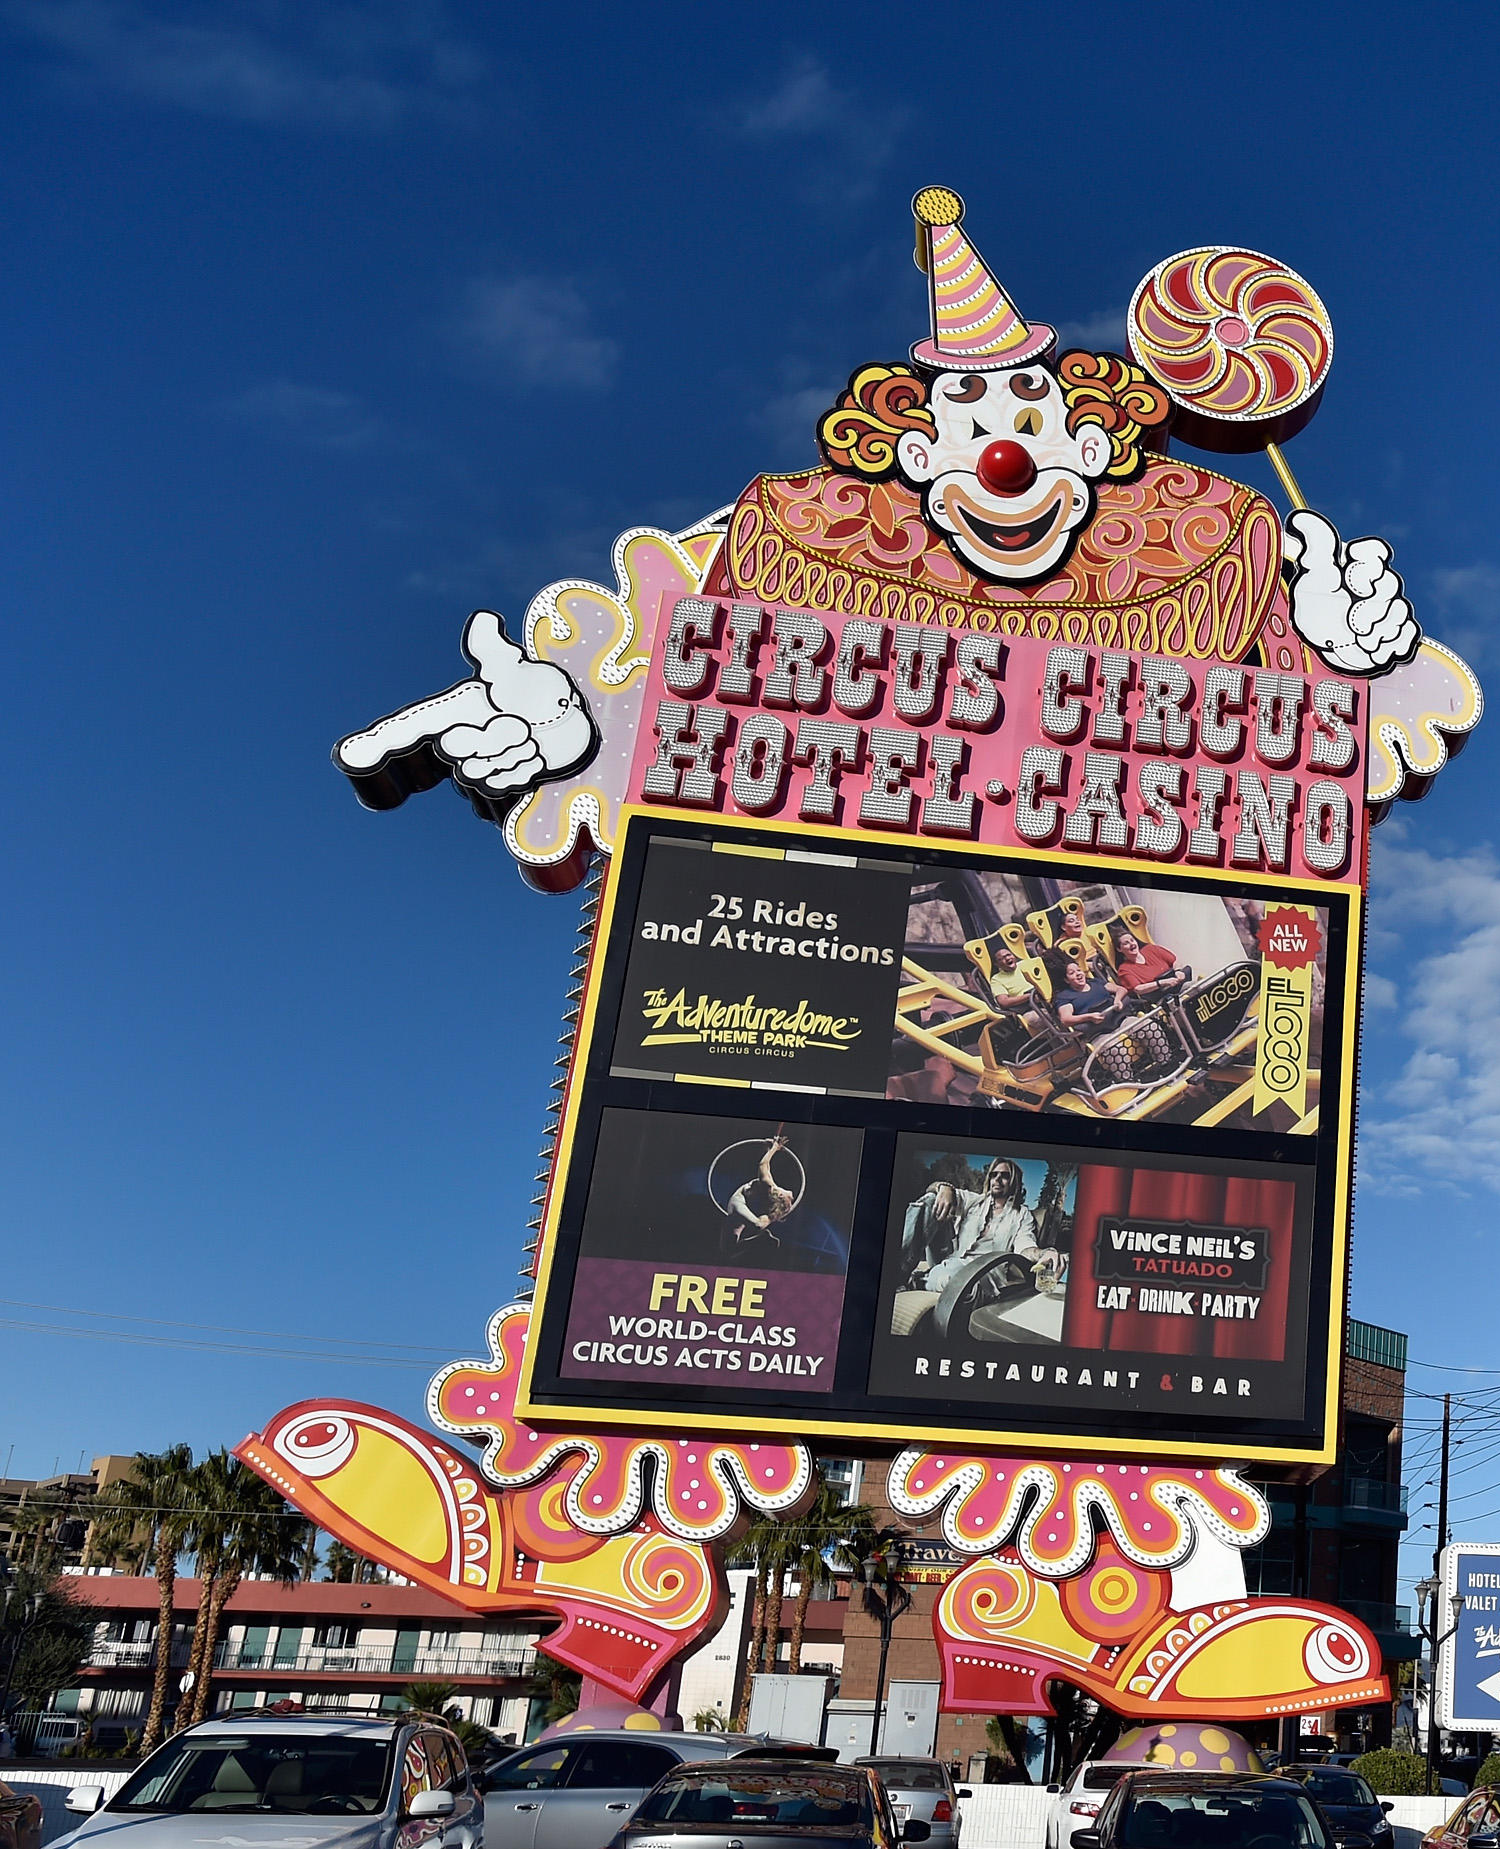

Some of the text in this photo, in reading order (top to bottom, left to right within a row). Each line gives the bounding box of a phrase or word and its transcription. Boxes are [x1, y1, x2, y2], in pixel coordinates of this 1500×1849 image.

[660, 596, 1357, 769] CIRCUS CIRCUS
[643, 700, 1349, 874] HOTEL CASINO
[707, 894, 838, 931] 25 Rides
[641, 919, 894, 965] and Attractions
[1269, 938, 1308, 952] NEW
[1273, 923, 1303, 938] ALL
[643, 987, 667, 1007] The
[700, 1029, 807, 1048] THEME PARK
[709, 1046, 795, 1058] CIRCUS CIRCUS
[1132, 1257, 1233, 1279] TATUADO
[649, 1272, 768, 1318] FREE
[1097, 1285, 1261, 1320] EAT DRINK PARTY
[608, 1315, 797, 1347] WORLD-CLASS
[572, 1341, 824, 1376] CIRCUS ACTS DAILY
[915, 1356, 1253, 1397] RESTAURANT & BAR
[898, 1542, 964, 1562] Trave
[1464, 1595, 1498, 1611] VALET
